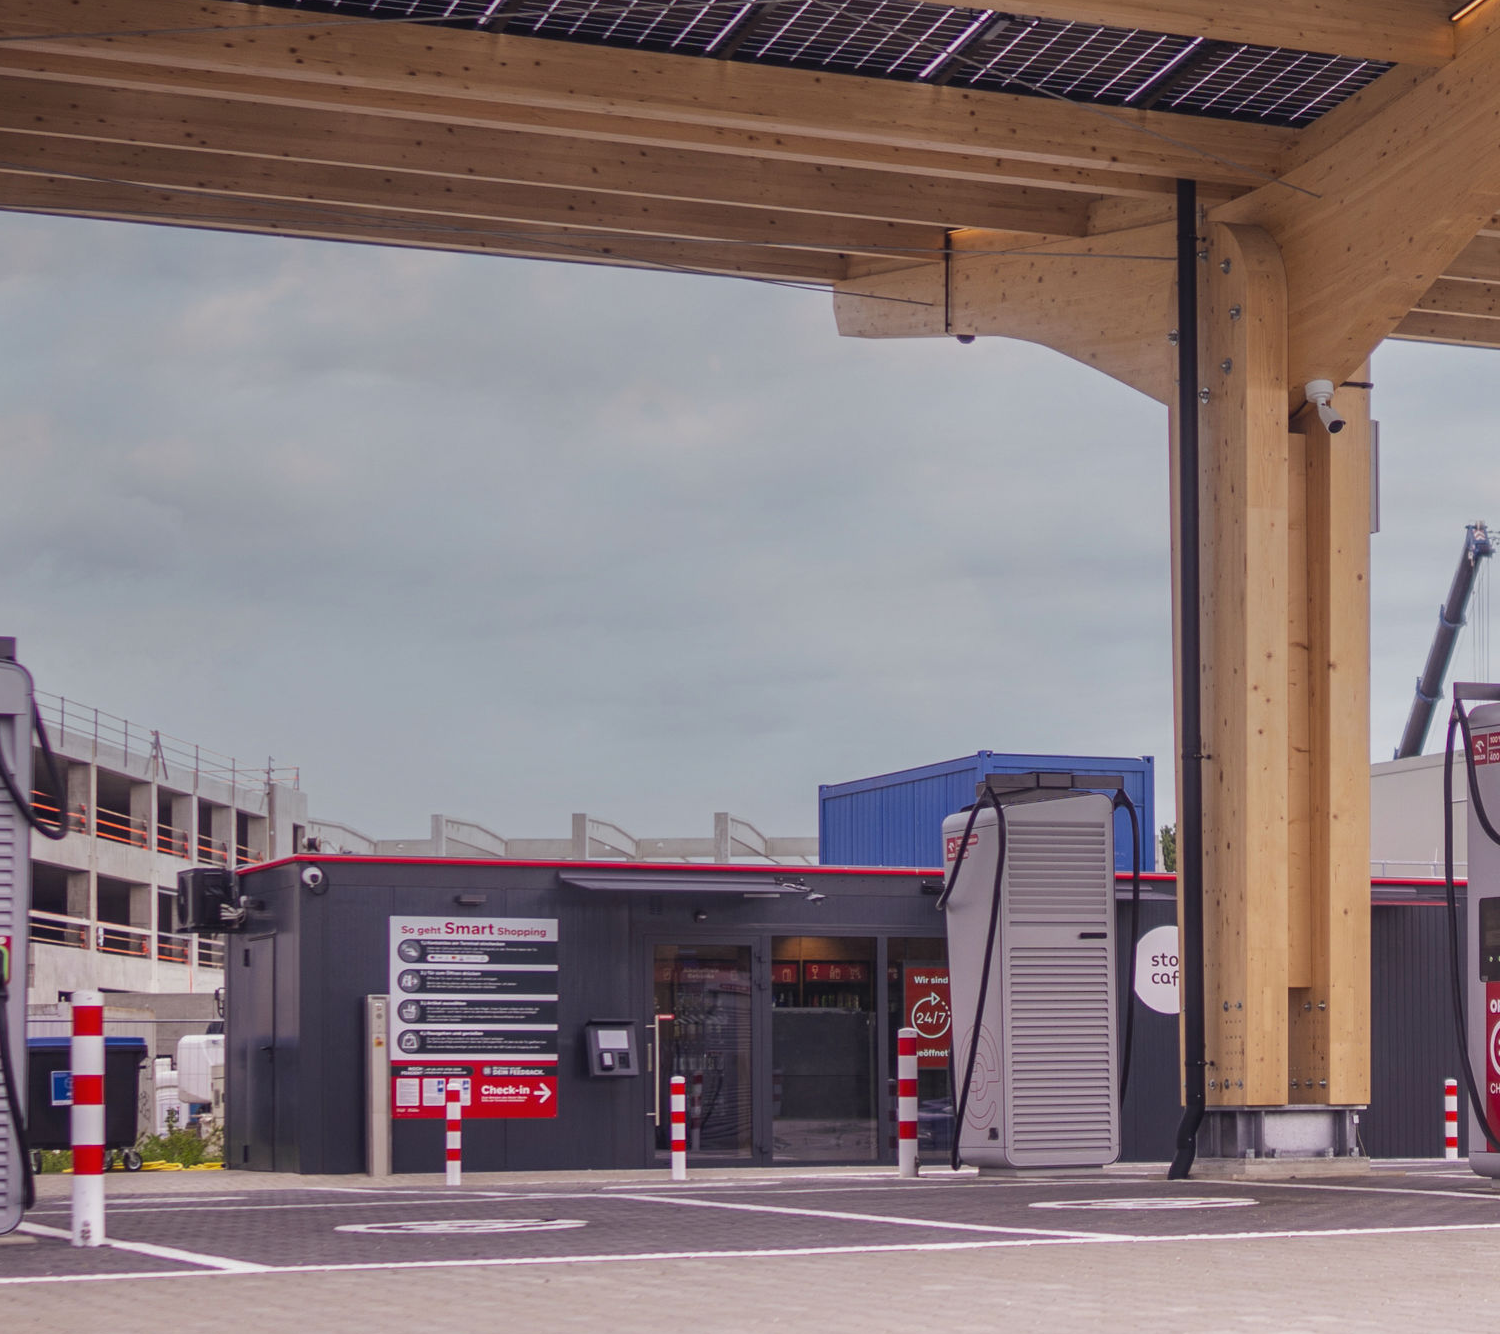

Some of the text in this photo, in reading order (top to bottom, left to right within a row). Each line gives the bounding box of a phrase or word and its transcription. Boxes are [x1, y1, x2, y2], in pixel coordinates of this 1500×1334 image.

[401, 921, 547, 938] So geht Smart Shopping
[1151, 953, 1179, 967] sto
[914, 975, 949, 985] Wir sind
[1151, 970, 1179, 987] caf
[916, 1011, 946, 1024] 24/7
[481, 1085, 530, 1095] Check-in
